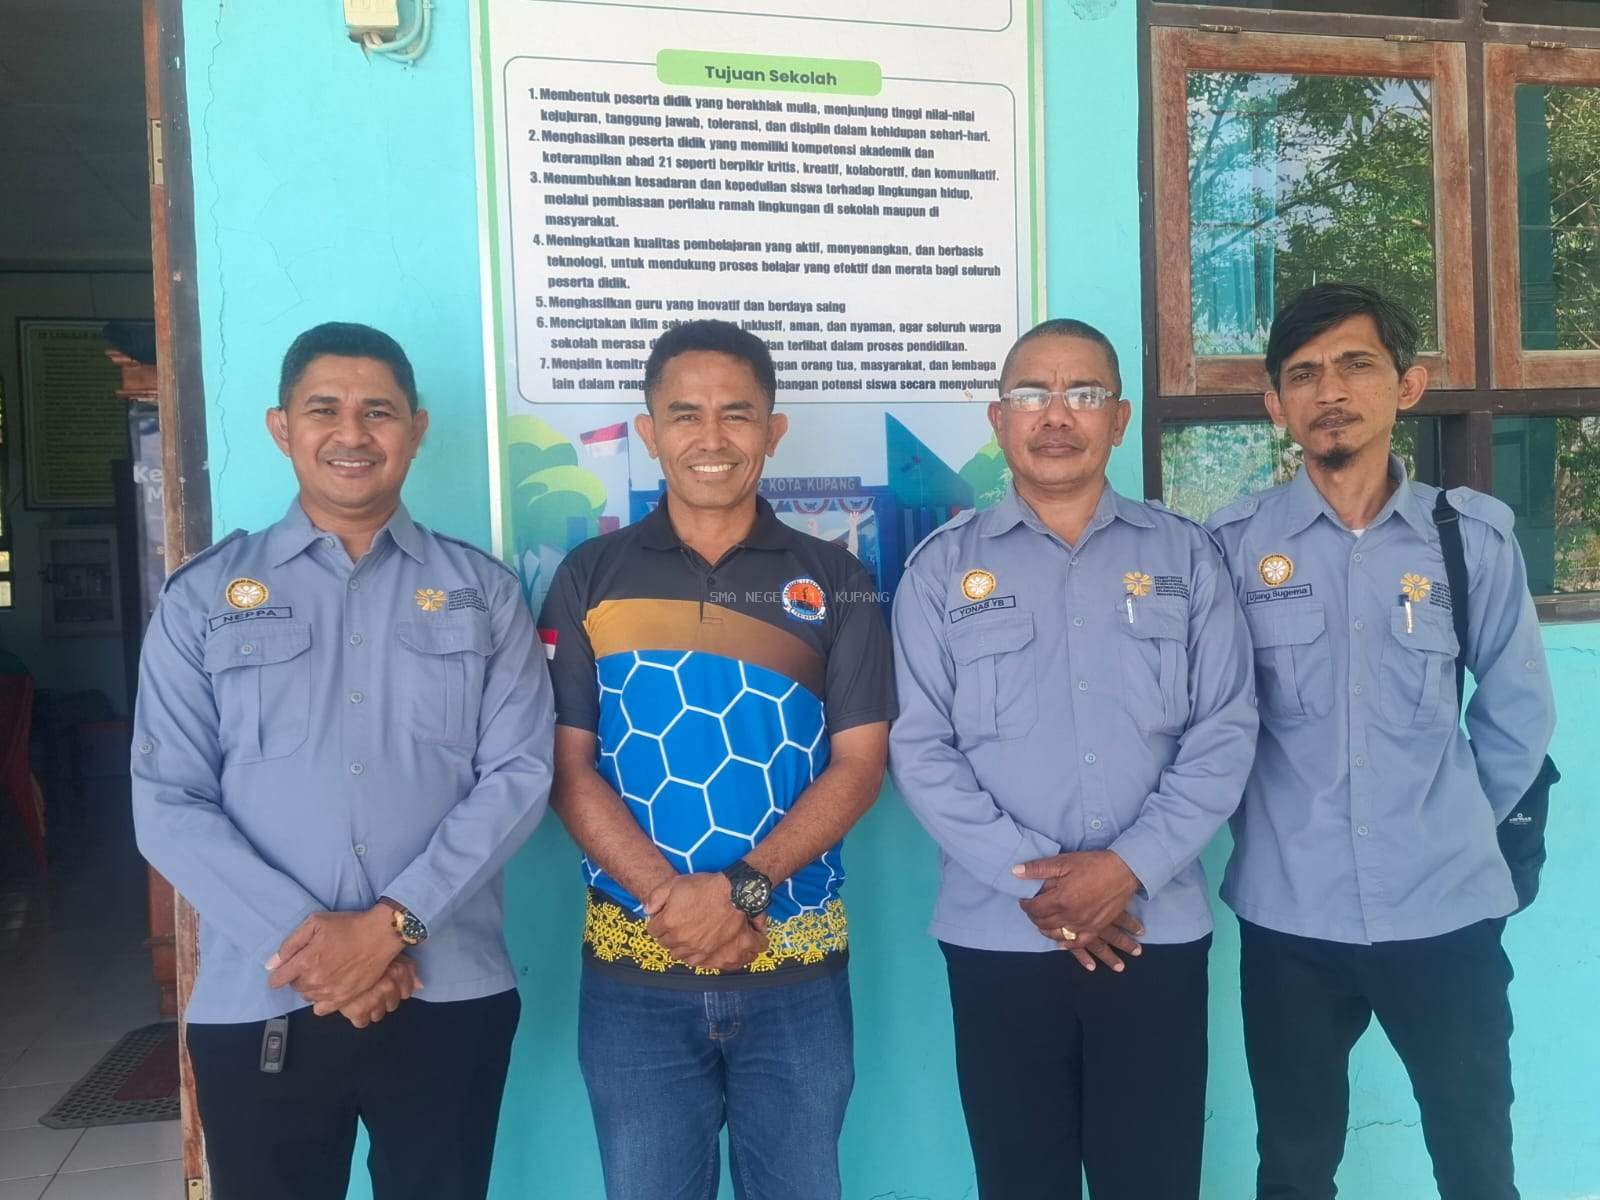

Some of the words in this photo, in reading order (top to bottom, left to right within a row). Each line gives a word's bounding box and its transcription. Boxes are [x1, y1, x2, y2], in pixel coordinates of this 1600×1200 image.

[704, 65, 765, 83] Tujuan
[768, 69, 837, 85] Sekolah
[528, 87, 538, 100] 1.
[539, 88, 610, 103] Membentuk
[613, 93, 660, 106] peserta
[662, 94, 692, 107] didik
[694, 98, 723, 110] yang
[726, 98, 783, 112] berakhlak
[786, 101, 820, 115] mulia,
[823, 104, 888, 118] menjunjung
[891, 106, 922, 120] tinggi
[925, 108, 975, 122] nilai-nilai
[540, 109, 601, 123] kejujuran,
[604, 113, 662, 127] tanggung
[664, 115, 704, 129] jawab,
[706, 117, 762, 131] toleransi,
[764, 120, 786, 132] dan
[789, 121, 830, 135] disiplin
[833, 123, 867, 136] dalam
[870, 125, 926, 139] kehidupan
[929, 129, 990, 142] sehari-hari.
[528, 129, 540, 142] 2.
[541, 130, 625, 145] Menghasilkan
[628, 135, 674, 147] peserta
[677, 136, 706, 149] didik
[708, 139, 737, 151] yang
[740, 140, 788, 152] memiliki
[791, 141, 856, 155] kompetensi
[859, 145, 911, 158] akademik
[914, 146, 934, 159] dan
[542, 151, 622, 166] keterampilan
[625, 154, 654, 167] abad
[658, 155, 672, 168] 21
[675, 158, 716, 170] seperti
[719, 158, 764, 172] berpikir
[766, 160, 799, 173] kritis,
[802, 162, 842, 175] kreatif,
[845, 164, 908, 177] kolaboratif,
[910, 166, 931, 178] dan
[934, 168, 999, 181] komunikatif.
[529, 171, 541, 184] 3.
[542, 172, 631, 187] Menumbuhkan
[634, 176, 696, 189] kesadaran
[699, 177, 722, 190] dan
[724, 179, 787, 192] kepedulian
[790, 182, 823, 194] siswa
[825, 183, 875, 196] terhadap
[877, 184, 937, 198] lingkungan
[940, 186, 973, 200] hidup,
[543, 193, 589, 206] melalui
[592, 195, 664, 208] pembiasaan
[668, 197, 715, 210] perilaku
[718, 200, 755, 211] ramah
[757, 200, 820, 214] lingkungan
[823, 202, 834, 214] di
[836, 203, 880, 216] sekolah
[882, 206, 926, 217] maupun
[928, 205, 939, 217] di
[544, 215, 619, 227] masyarakat.
[532, 234, 544, 246] 4.
[545, 234, 630, 248] Meningkatkan
[633, 236, 680, 249] kualitas
[683, 239, 762, 252] pembelajaran
[764, 242, 792, 253] yang
[795, 241, 823, 254] aktif,
[826, 243, 912, 256] menyenangkan,
[914, 244, 935, 256] dan
[937, 245, 984, 257] berbasis
[546, 255, 606, 269] teknologi,
[610, 257, 644, 269] untuk
[647, 258, 716, 271] mendukung
[718, 261, 758, 272] proses
[761, 260, 800, 273] belajar
[803, 263, 830, 274] yang
[833, 262, 868, 274] efektif
[871, 263, 892, 275] dan
[894, 264, 932, 275] merata
[935, 264, 958, 276] bagi
[961, 265, 1000, 276] seluruh
[547, 277, 594, 288] peserta
[597, 276, 630, 289] didik.
[535, 295, 547, 308] 5.
[548, 296, 632, 309] Menghasilkan
[634, 299, 662, 310] guru
[665, 299, 694, 311] yang
[696, 299, 740, 311] inovatif
[743, 299, 764, 312] dan
[767, 300, 813, 313] berdaya
[815, 301, 846, 313] saing
[536, 316, 548, 328] 6.
[549, 316, 626, 329] Menciptakan
[629, 317, 658, 329] iklim
[740, 319, 786, 332] inklusif,
[789, 321, 823, 332] aman,
[826, 320, 847, 332] dan
[849, 322, 895, 333] nyaman,
[898, 322, 923, 333] agar
[926, 321, 966, 333] seluruh
[968, 323, 1001, 334] warga
[550, 337, 598, 349] sekolah
[600, 339, 646, 350] merasa
[786, 339, 827, 351] terlibat
[830, 339, 864, 351] dalam
[866, 341, 904, 352] proses
[906, 340, 968, 352] pendidikan.
[539, 357, 550, 369] 7.
[550, 357, 602, 370] Menjalin
[800, 360, 833, 371] orang
[836, 359, 856, 371] tua,
[860, 360, 926, 372] masyarakat,
[928, 359, 948, 371] dan
[951, 359, 996, 371] lembaga
[552, 377, 575, 390] lain
[578, 378, 615, 390] dalam
[821, 379, 862, 391] potensi
[865, 378, 897, 390] siswa
[899, 379, 936, 390] secara
[938, 378, 1000, 391] menyeluruh
[769, 479, 801, 492] KOTA
[807, 478, 855, 491] KUPANG
[1249, 591, 1271, 601] Ujang
[223, 609, 277, 623] NEPPA
[960, 601, 990, 616] YONAS
